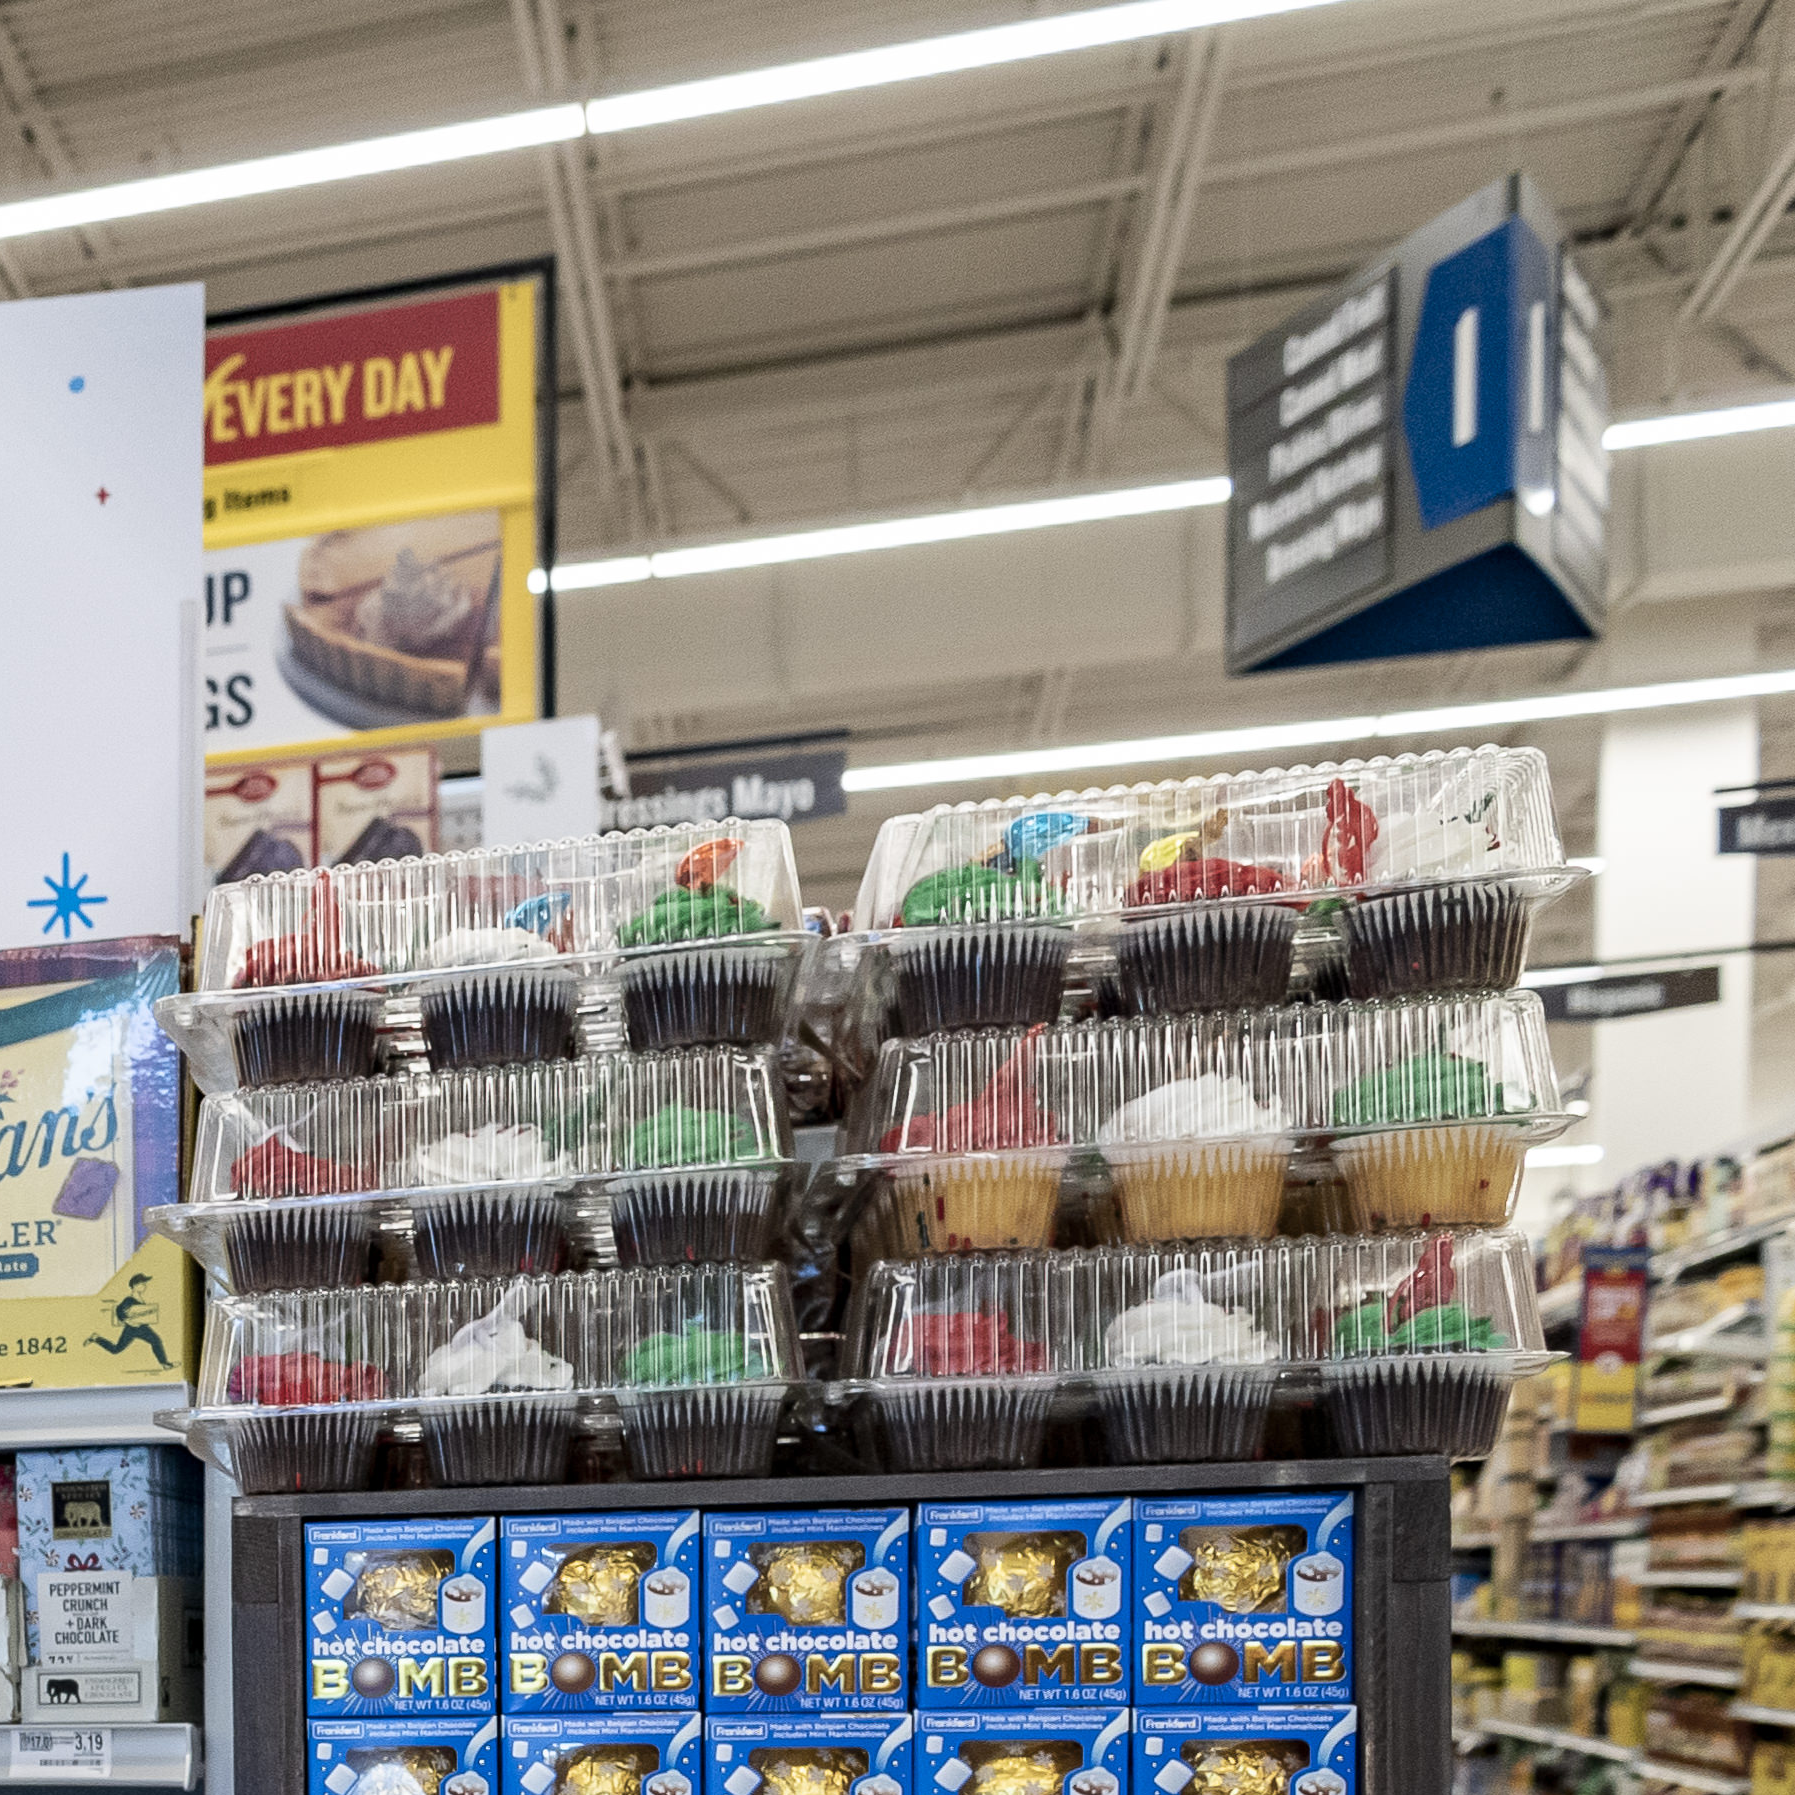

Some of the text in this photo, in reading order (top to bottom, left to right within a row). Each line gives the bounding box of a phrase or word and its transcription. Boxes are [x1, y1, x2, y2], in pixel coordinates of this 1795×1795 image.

[1452, 306, 1479, 449] 1
[213, 345, 453, 443] EVERY DAY
[15, 1336, 68, 1356] 1842
[49, 1582, 120, 1596] PEPPERMINT
[62, 1598, 108, 1612] CRUNCH
[76, 1616, 108, 1630] DARK
[54, 1630, 120, 1646] CHOCOLATE
[314, 1635, 485, 1655] hot chocolate
[394, 1699, 417, 1711] NET
[419, 1699, 434, 1710] WT
[437, 1699, 451, 1710] 1.6
[454, 1698, 468, 1709] OZ
